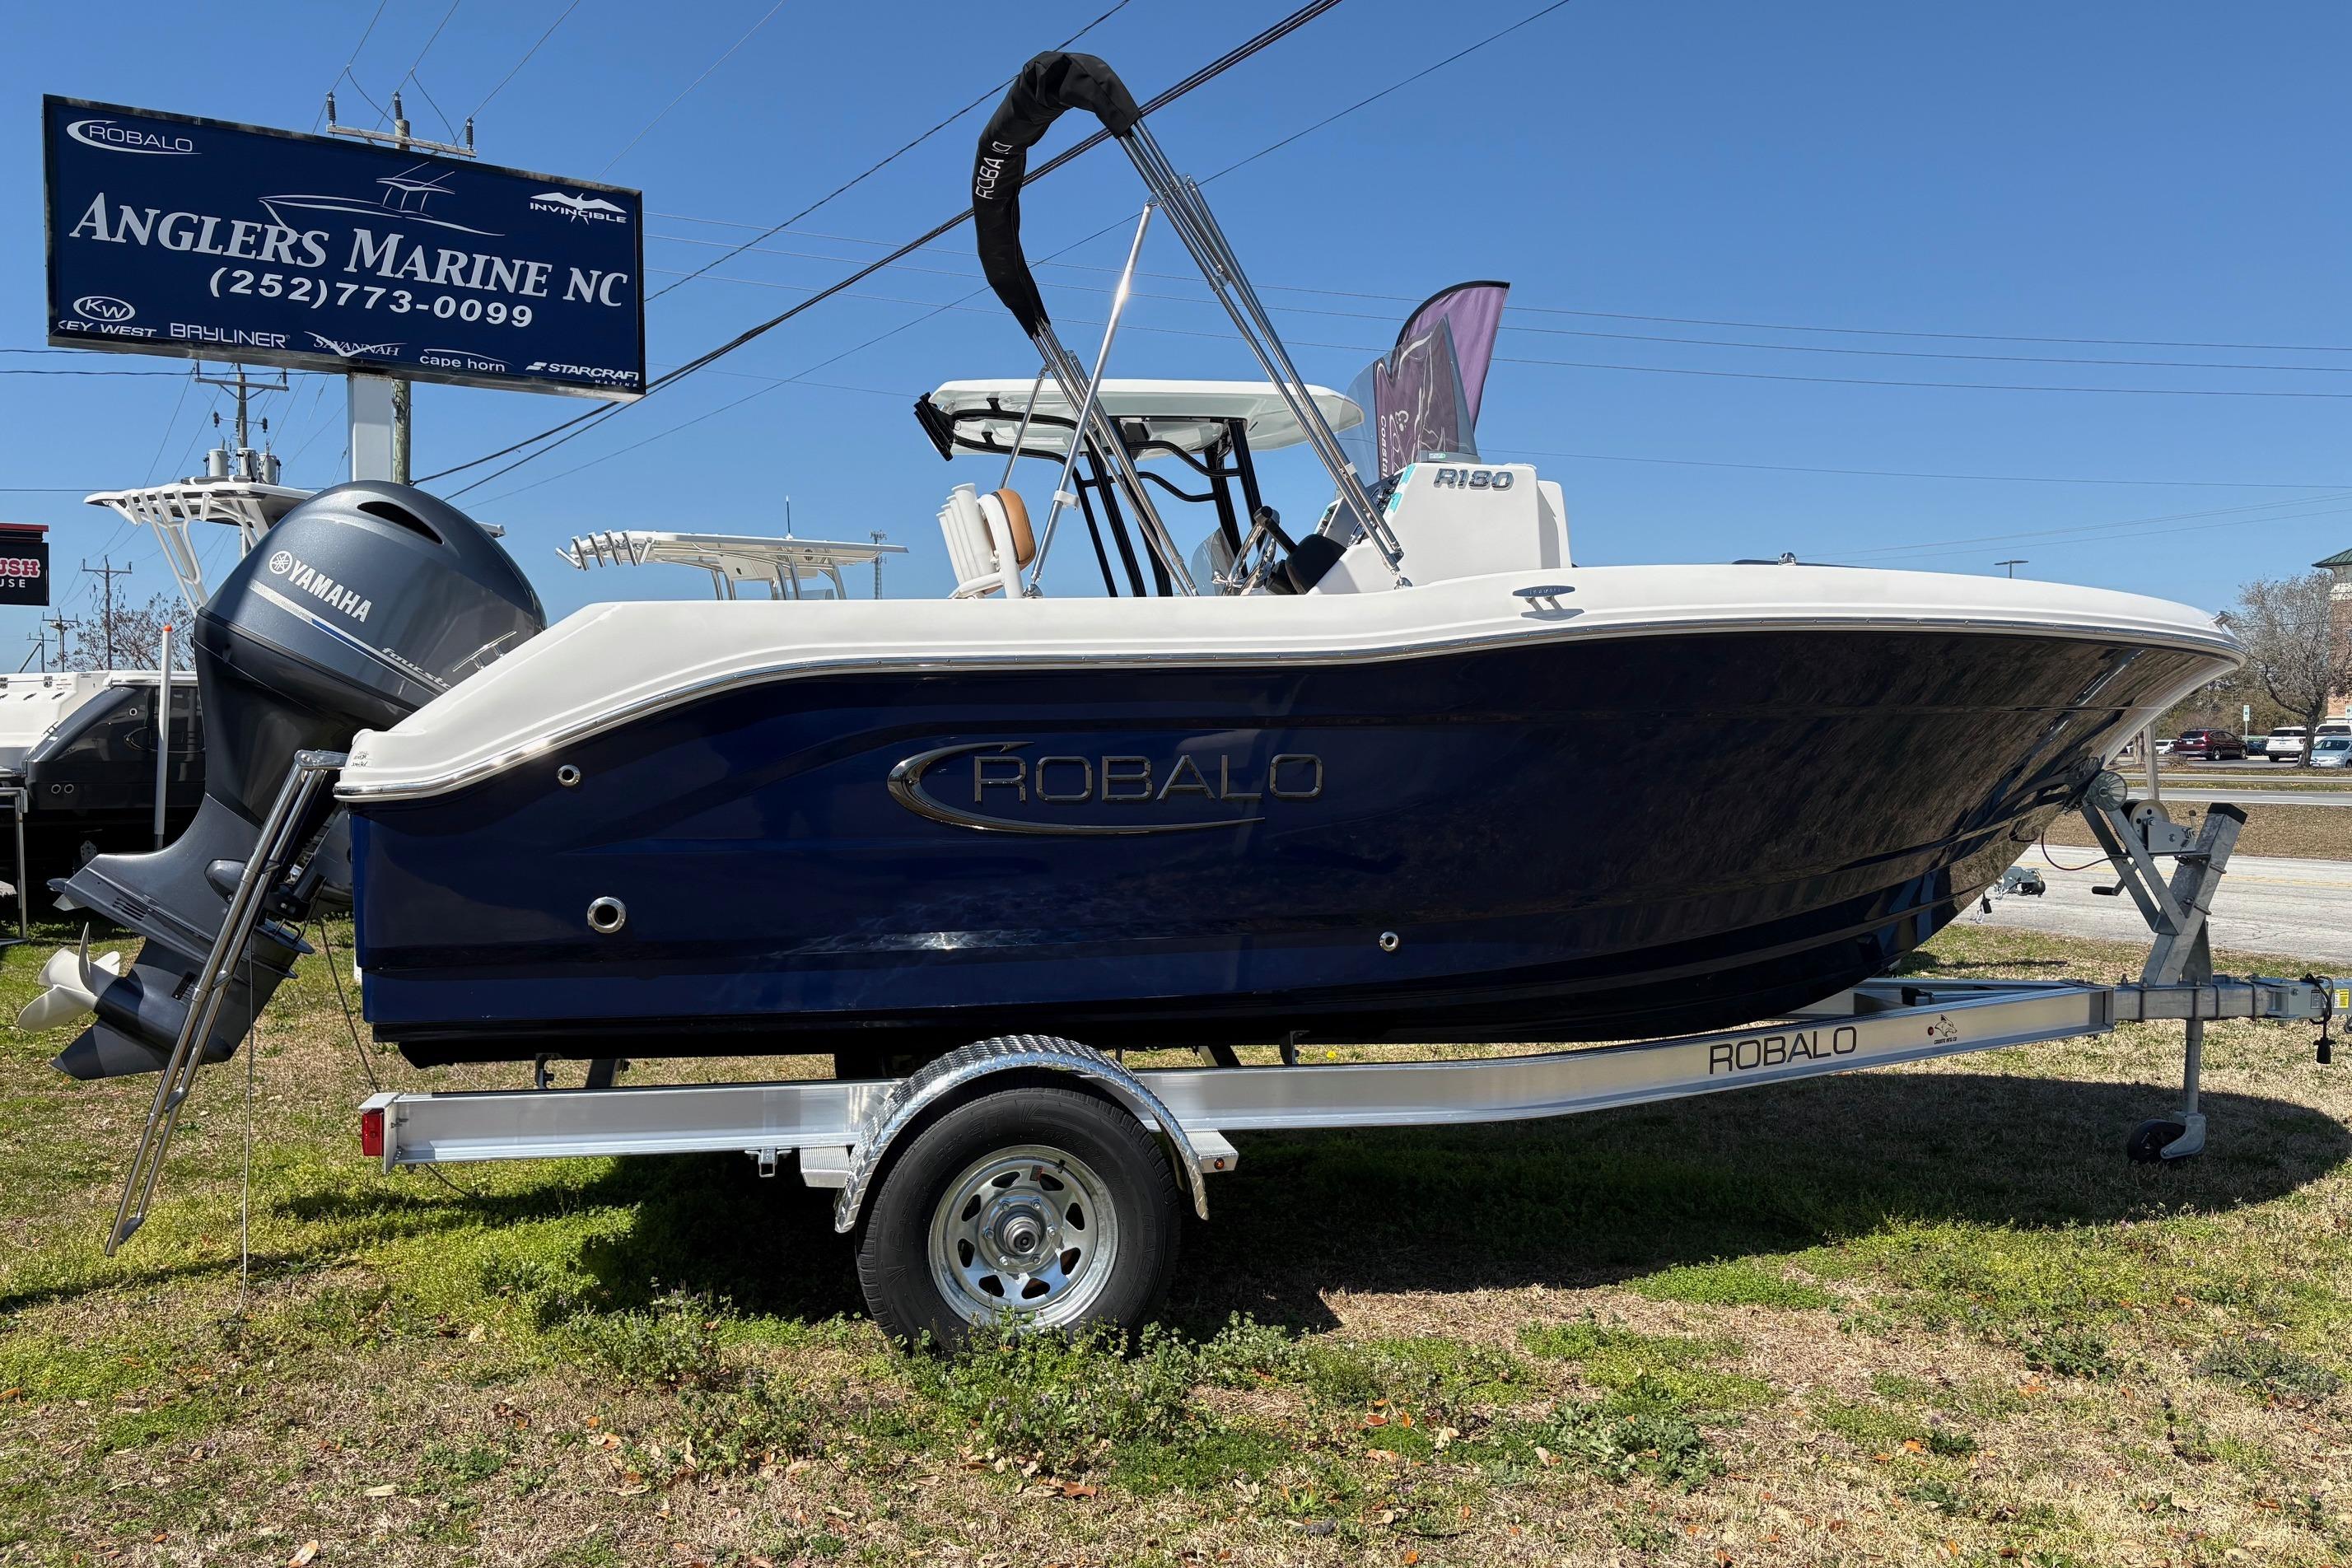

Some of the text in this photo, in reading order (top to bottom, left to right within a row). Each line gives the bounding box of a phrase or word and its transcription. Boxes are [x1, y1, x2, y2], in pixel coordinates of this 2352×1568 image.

[89, 124, 194, 153] ROBALO
[530, 202, 628, 224] INVINCIBLE
[69, 192, 628, 308] ANGLERS MARINE NC
[85, 299, 128, 319] KW
[209, 266, 533, 329] (252)773-0099
[100, 324, 157, 338] WEST
[419, 355, 506, 372] cape horn
[548, 363, 639, 381] STARCRAFT
[1433, 468, 1514, 491] R180
[288, 559, 372, 623] YAMAHA
[973, 754, 1324, 804] ROBALO
[1709, 1025, 1858, 1075] ROBALO
